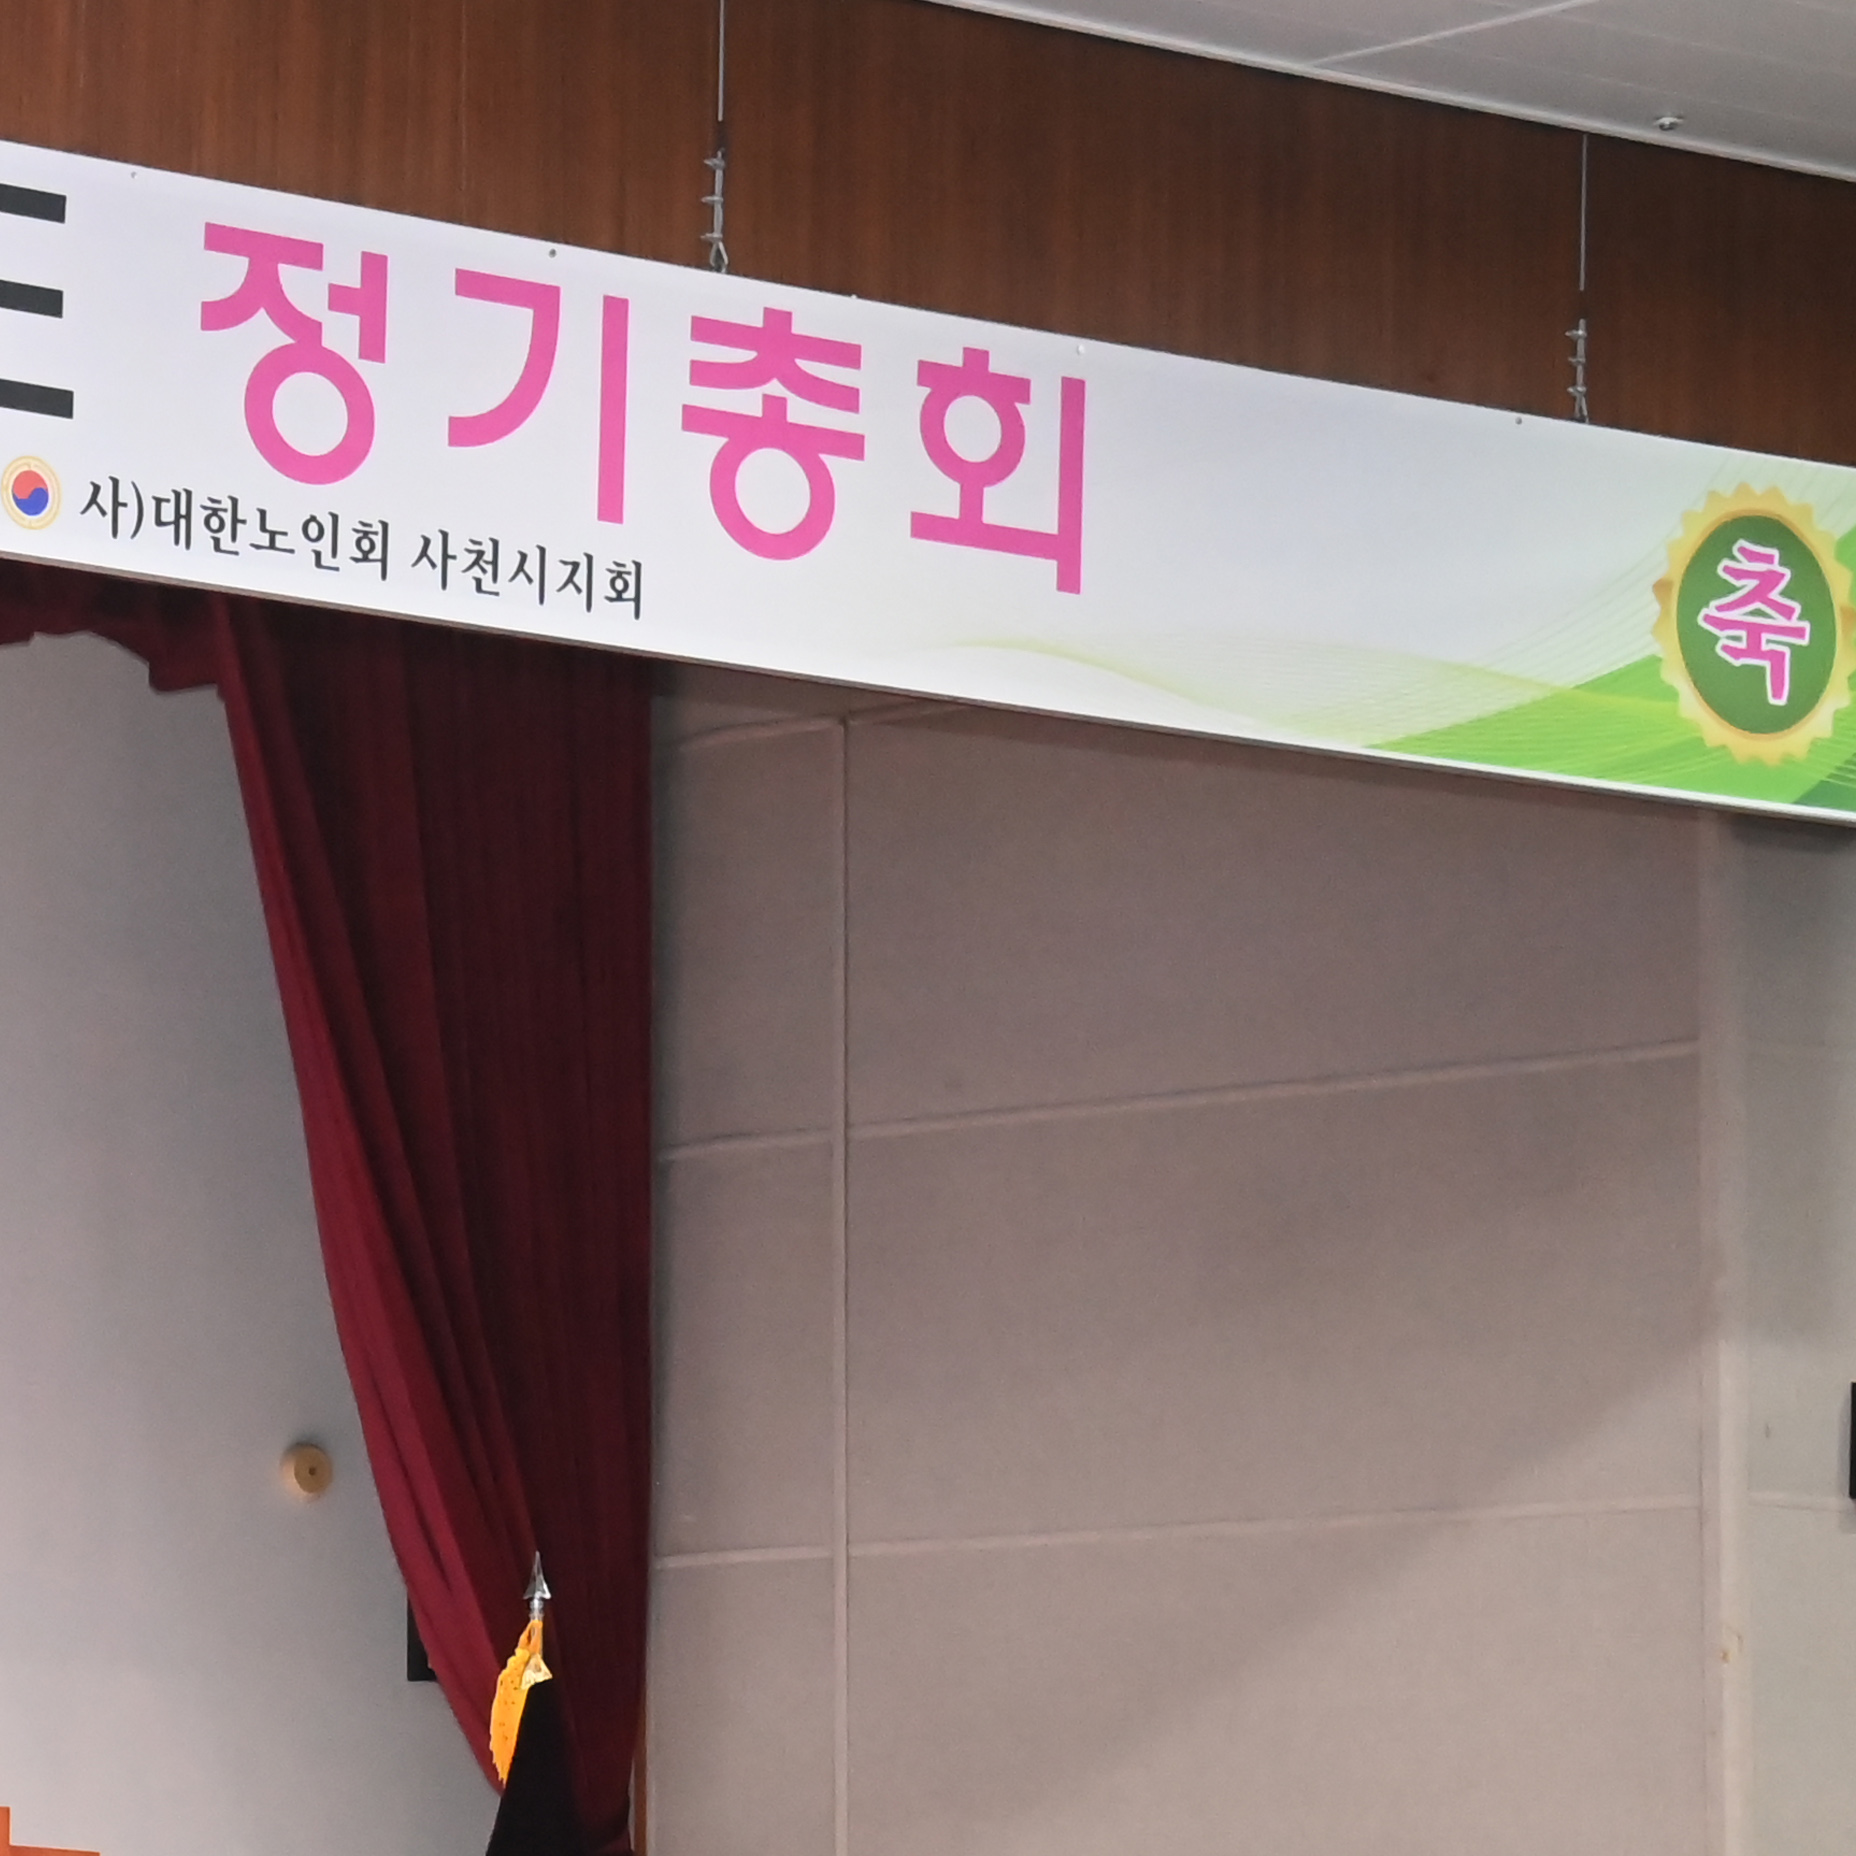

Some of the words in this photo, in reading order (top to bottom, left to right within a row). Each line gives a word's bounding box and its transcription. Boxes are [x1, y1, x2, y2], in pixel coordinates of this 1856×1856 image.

[199, 221, 1087, 596] 정기총회
[79, 474, 392, 583] 사)대한노인회
[409, 529, 644, 621] 사천시지회
[1701, 542, 1810, 704] 축
